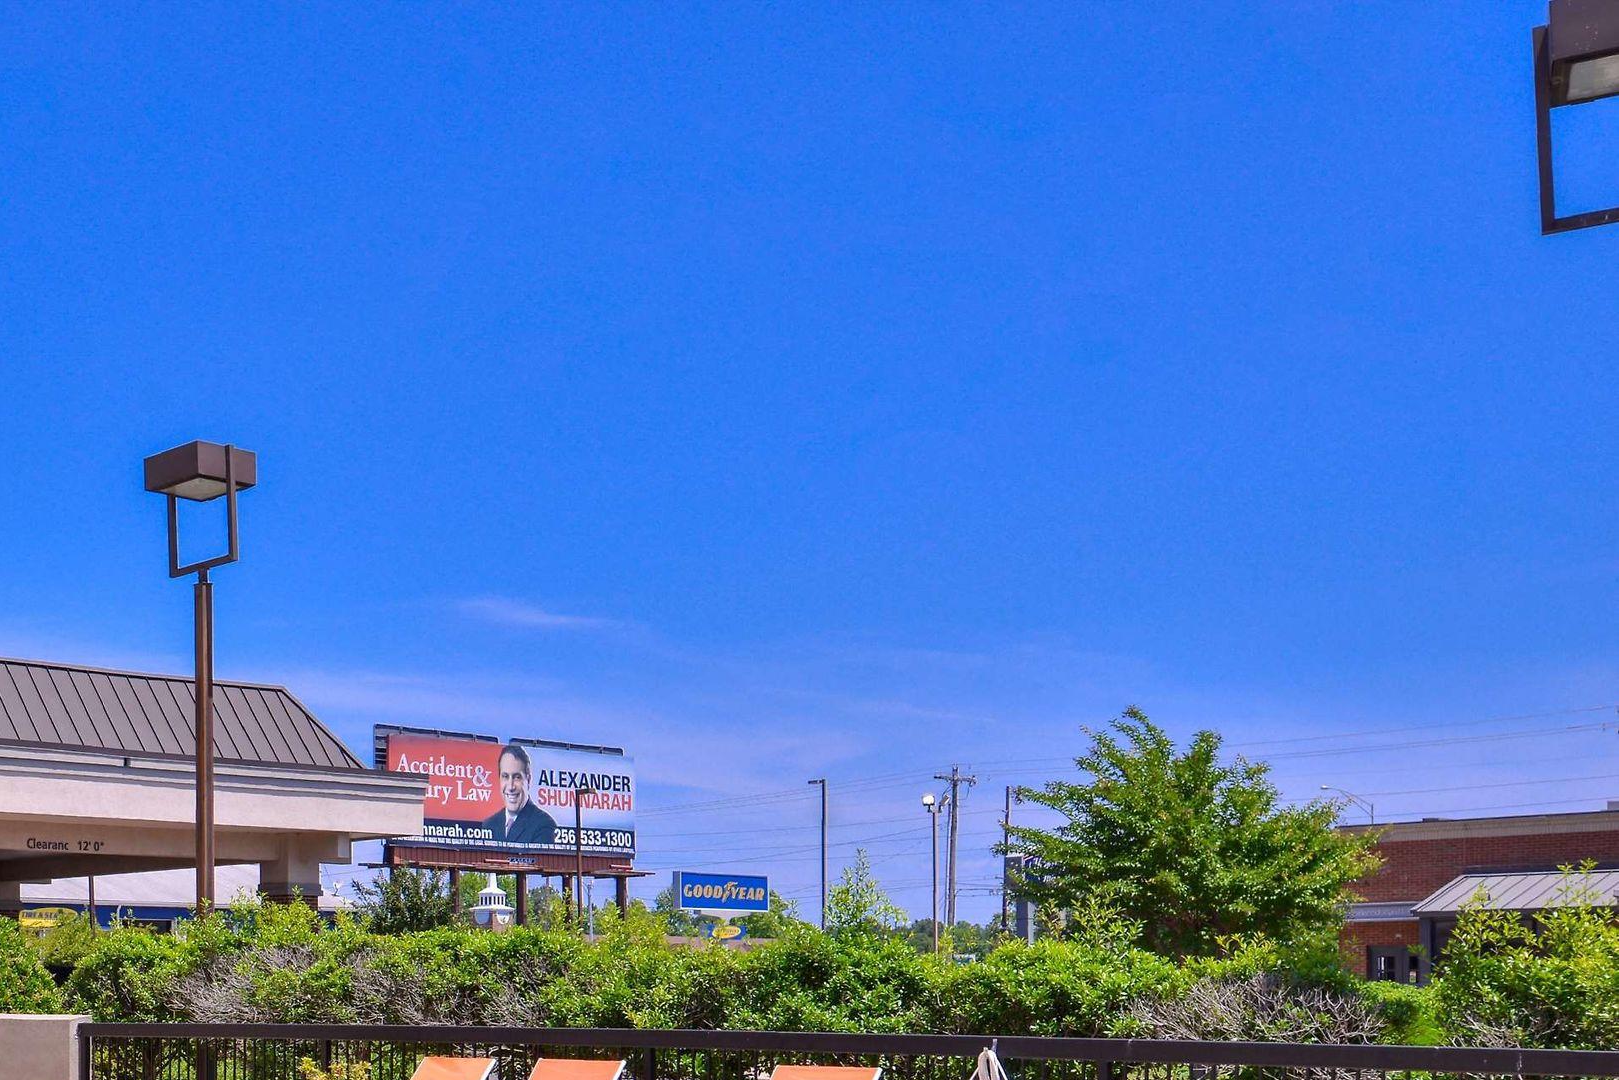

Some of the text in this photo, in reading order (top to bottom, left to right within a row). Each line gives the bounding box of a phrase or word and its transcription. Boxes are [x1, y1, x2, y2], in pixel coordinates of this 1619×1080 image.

[396, 753, 492, 788] Accident &
[538, 769, 631, 792] ALEXANDER
[456, 780, 492, 802] Law
[537, 788, 632, 811] SHUNNARAH
[26, 838, 69, 850] Clearanc
[554, 828, 576, 844] 256
[580, 831, 632, 847] 533-1300
[683, 882, 765, 902] GOODYEAR
